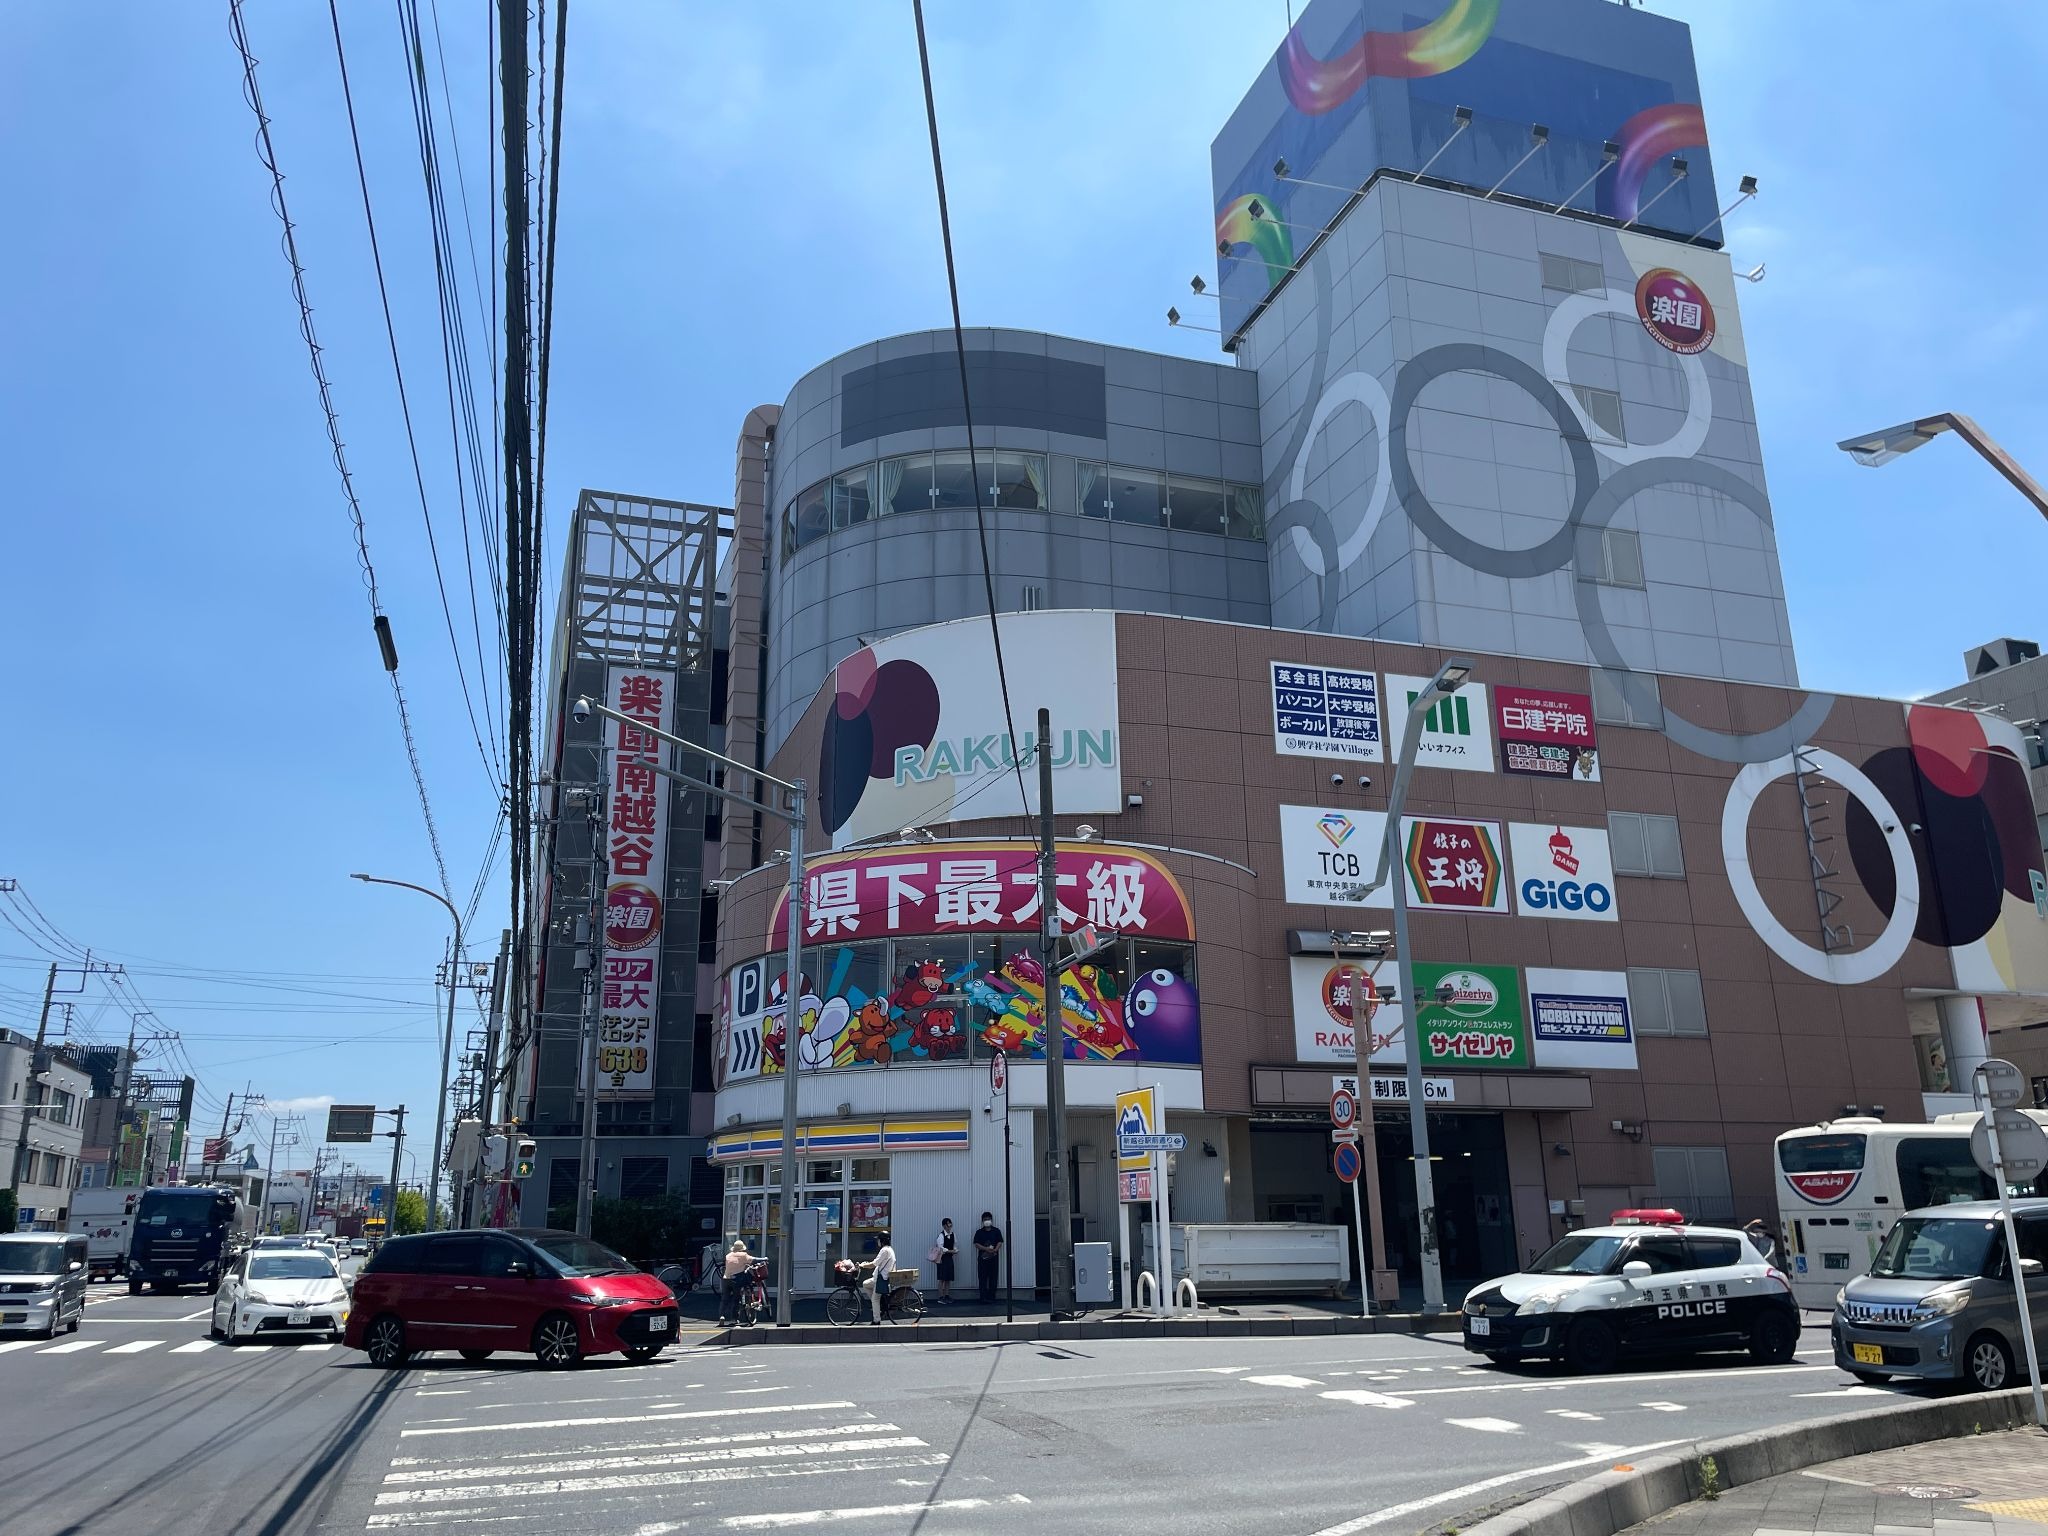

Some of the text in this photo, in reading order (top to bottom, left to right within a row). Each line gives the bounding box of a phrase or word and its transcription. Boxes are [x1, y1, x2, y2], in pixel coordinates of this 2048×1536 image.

[1652, 296, 1702, 330] 楽園
[1642, 317, 1713, 354] EXCITING AMUSEMENT
[1278, 670, 1320, 687] 英会話
[1327, 675, 1374, 691] 高校受験
[1278, 693, 1323, 709] パソコン
[1329, 698, 1376, 714] 大学受験
[1280, 716, 1325, 731] ボーカル
[1336, 718, 1371, 730] 放課後等
[1503, 707, 1588, 736] 日建学院
[1332, 728, 1377, 740] デイサービス
[1341, 744, 1374, 756] Village
[1507, 743, 1570, 760] 建築士 宅建士
[610, 675, 663, 876] 楽園南越谷
[1433, 832, 1472, 849] 餃子の
[1318, 851, 1360, 877] TCB
[1555, 854, 1578, 871] GAME
[1426, 857, 1485, 892] 王将
[807, 860, 1148, 938] 県下最大級
[1522, 879, 1611, 912] GiGO
[604, 961, 648, 978] エリア
[603, 984, 649, 1009] 最大
[1541, 1024, 1608, 1034] ホビーステーション
[1315, 1032, 1391, 1048] RAKEN
[1430, 1033, 1514, 1057] サイゼリヤ
[611, 1072, 626, 1087] 台
[1335, 1101, 1350, 1118] 30
[1802, 1177, 1844, 1187] ASAHI
[1658, 1301, 1726, 1320] POLICE
